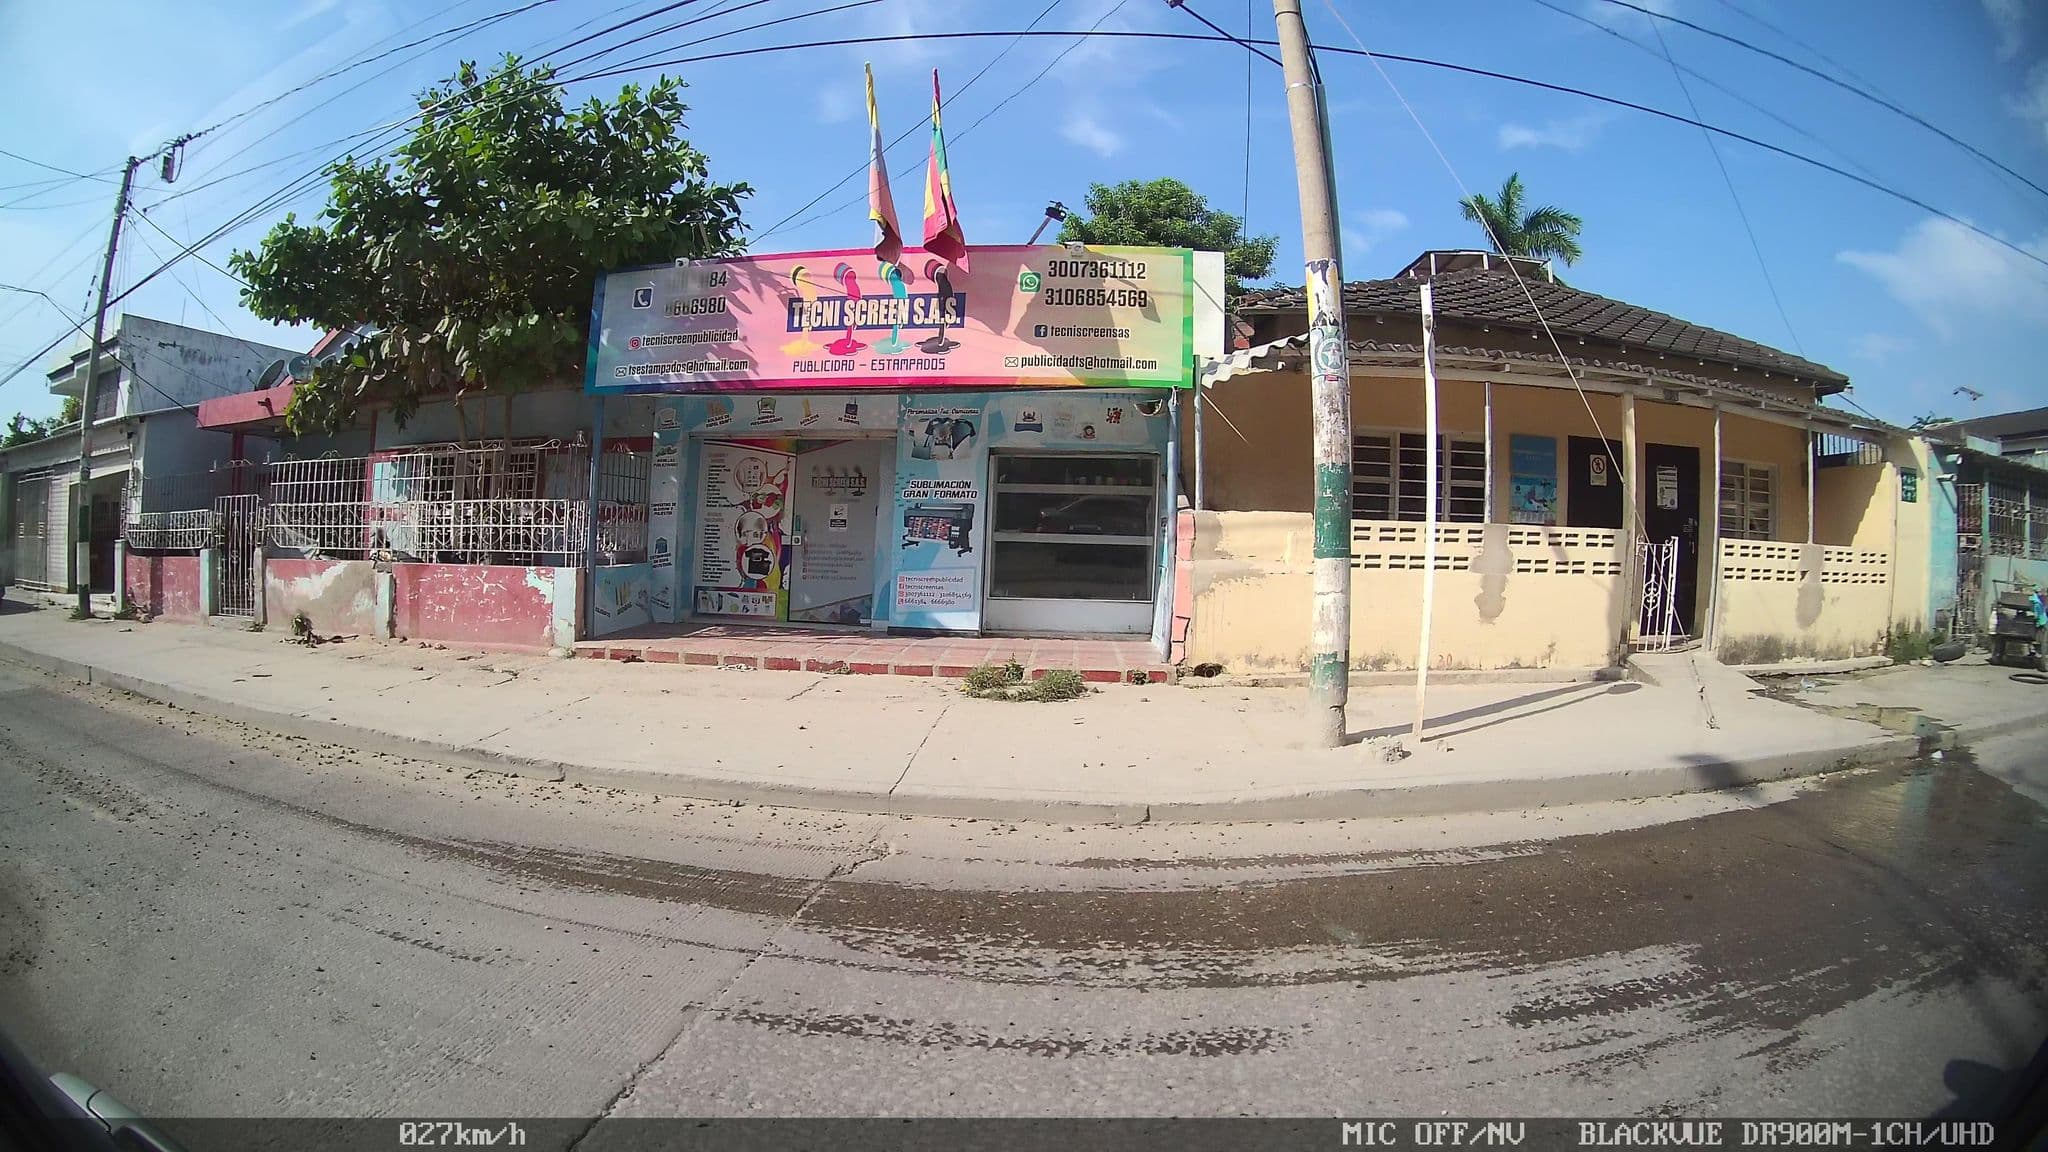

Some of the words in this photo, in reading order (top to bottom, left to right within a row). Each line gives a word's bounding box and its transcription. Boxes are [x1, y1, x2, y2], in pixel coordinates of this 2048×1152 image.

[1048, 260, 1146, 279] 3007361112
[1045, 288, 1148, 308] 3106854569
[792, 300, 840, 329] TECNI
[844, 298, 910, 328] SCREEN
[913, 297, 961, 325] S.A.S.
[642, 328, 739, 348] tecniscreenpublicidad
[1050, 325, 1130, 339] tecniscreensas
[628, 359, 748, 376] tsestampados@hotmail.com
[793, 359, 854, 373] PUBLICIDAD
[871, 358, 945, 371] ESTAMPADOS
[1021, 354, 1157, 370] publicidadts@hotmail.com
[910, 479, 972, 489] SUBLIMACIÓN
[903, 490, 929, 498] GRAN
[934, 490, 977, 499] FORMATO
